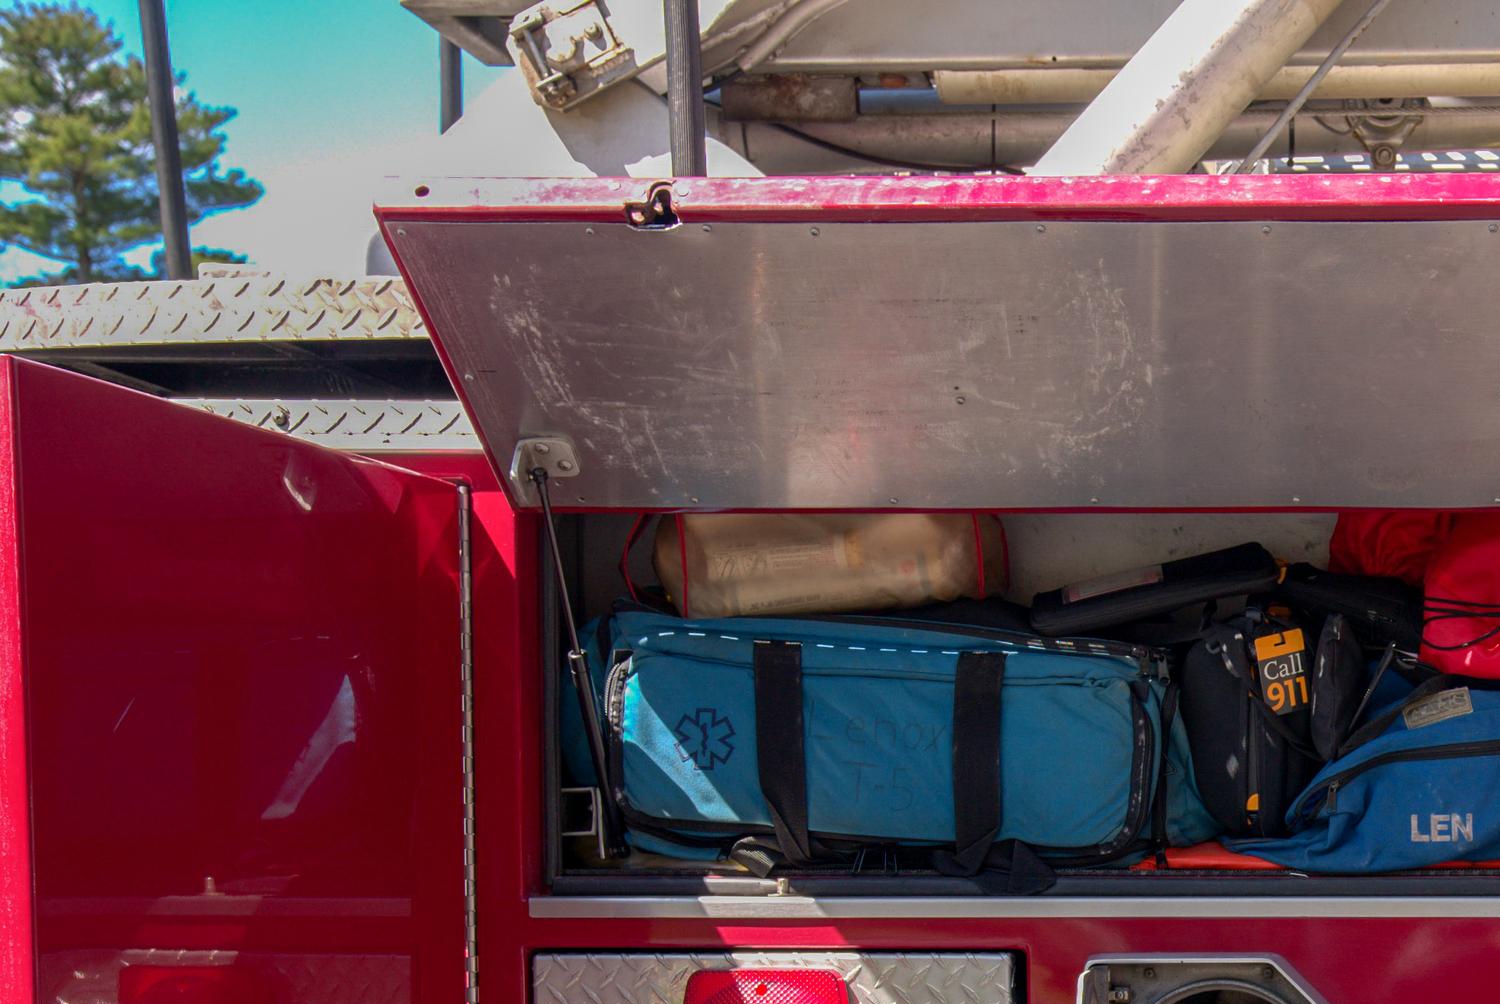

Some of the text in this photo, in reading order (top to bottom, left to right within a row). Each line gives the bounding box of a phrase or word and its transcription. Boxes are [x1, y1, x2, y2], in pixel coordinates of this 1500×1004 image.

[1263, 652, 1304, 681] Call
[1266, 675, 1309, 712] 911
[1410, 812, 1473, 843] LEN
